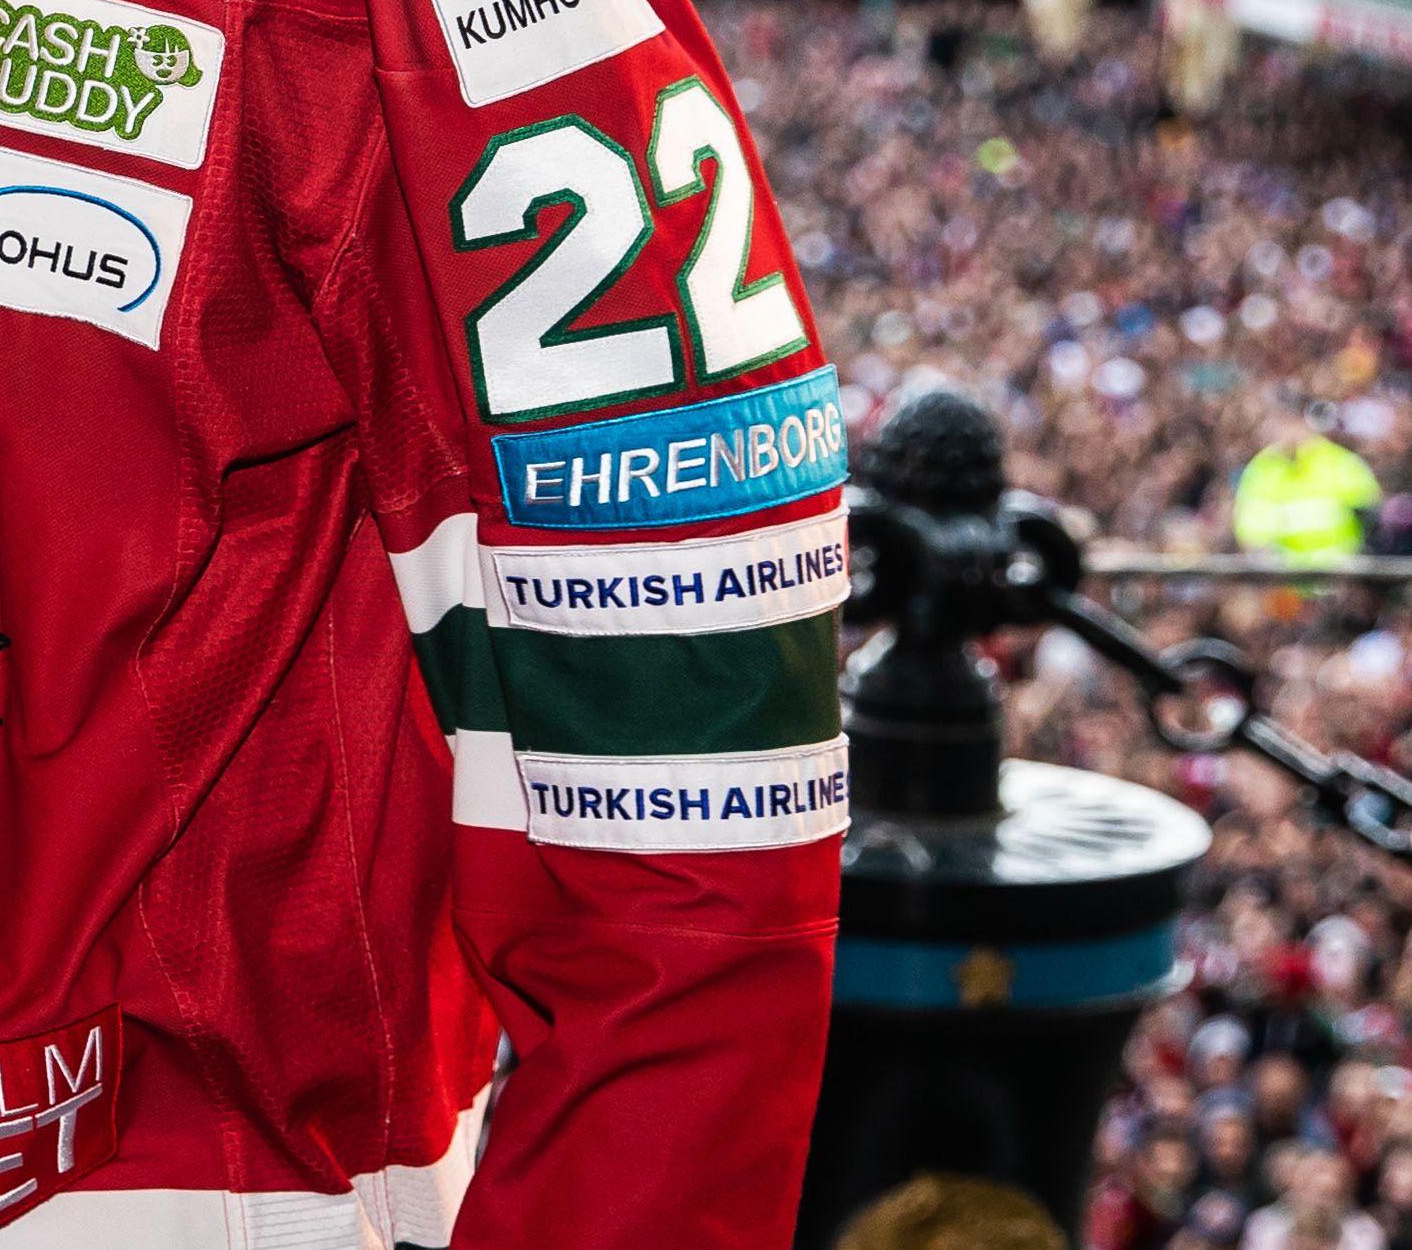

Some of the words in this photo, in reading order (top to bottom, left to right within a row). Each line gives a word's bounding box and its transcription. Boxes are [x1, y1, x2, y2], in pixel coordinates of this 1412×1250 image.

[450, 77, 811, 423] 22
[525, 401, 842, 509] EHRENBORG
[507, 565, 706, 610] TURKISH
[715, 542, 844, 603] AIRLINES
[531, 779, 711, 822] TURKISH
